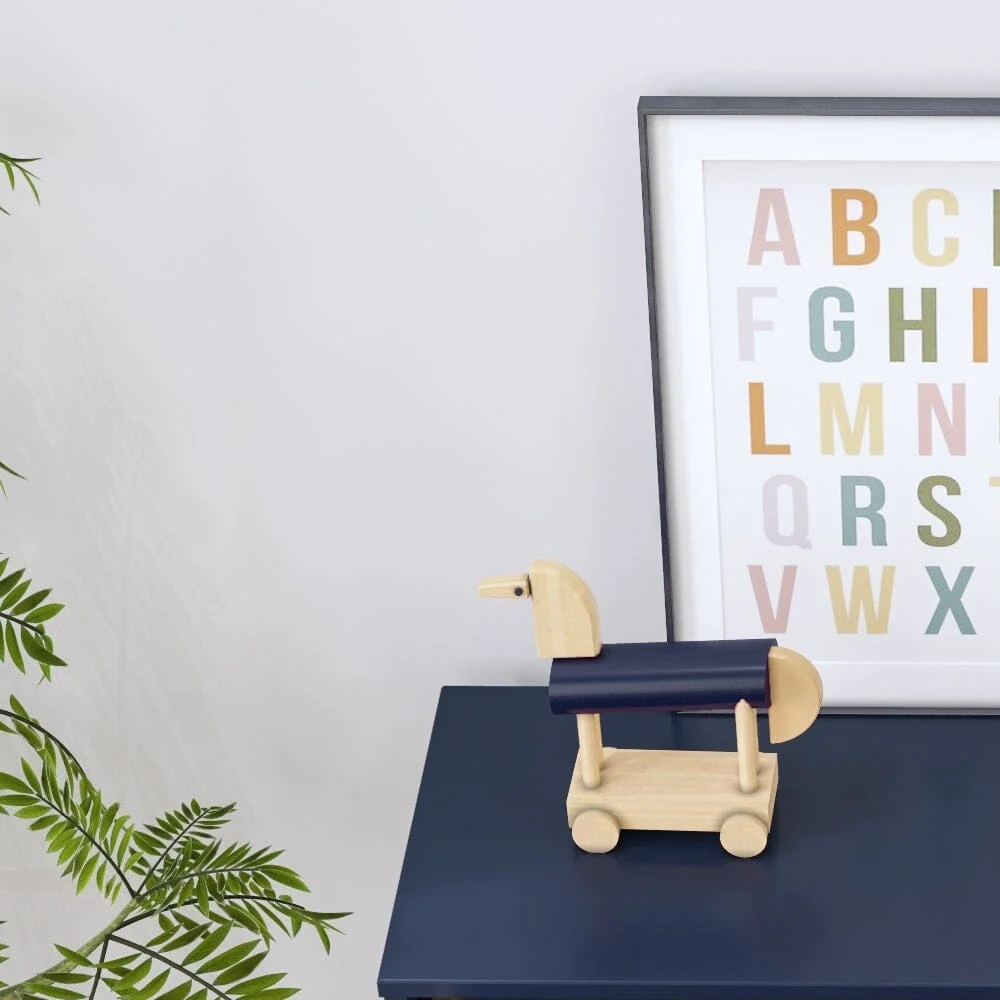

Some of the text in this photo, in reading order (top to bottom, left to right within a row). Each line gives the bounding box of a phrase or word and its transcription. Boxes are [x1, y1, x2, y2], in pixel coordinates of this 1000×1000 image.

[747, 188, 801, 266] A
[830, 188, 881, 267] B
[912, 188, 960, 267] C
[736, 286, 778, 362] F
[807, 286, 856, 363] G
[888, 287, 938, 363] H
[971, 287, 989, 364] I
[748, 382, 791, 455] L
[819, 382, 885, 456] M
[917, 383, 966, 456] N
[762, 474, 812, 550] Q
[840, 475, 888, 547] R
[916, 475, 962, 548] S
[747, 565, 798, 634] V
[825, 565, 896, 635] W
[924, 566, 977, 636] X
